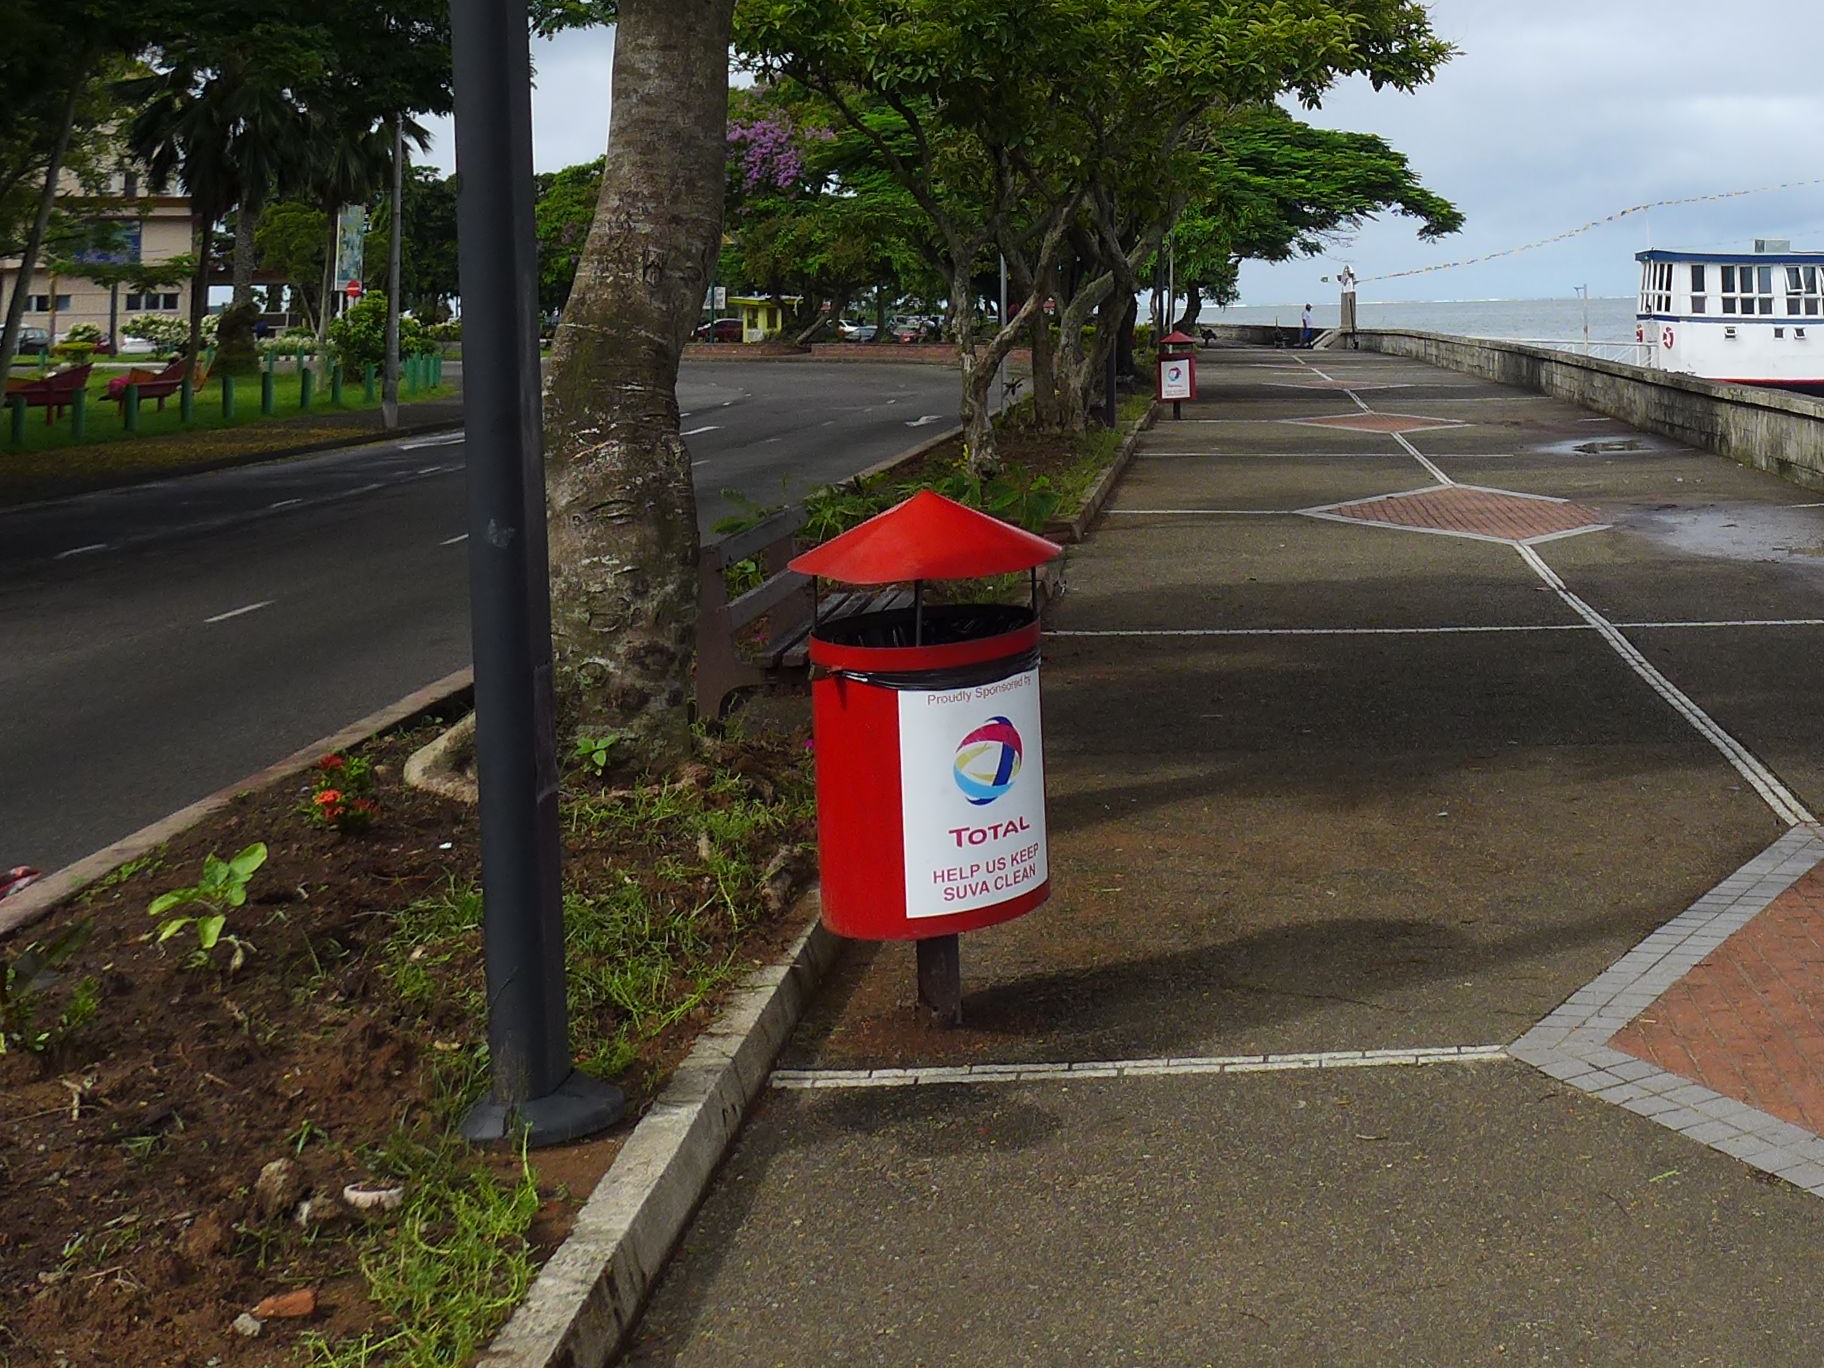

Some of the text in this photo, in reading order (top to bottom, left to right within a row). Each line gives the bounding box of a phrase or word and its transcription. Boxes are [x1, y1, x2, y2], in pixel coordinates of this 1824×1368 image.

[927, 674, 1032, 706] Proudly Sponsored by
[948, 816, 1030, 848] TOTAL
[933, 842, 1039, 884] HELP US KEEP
[943, 862, 1036, 902] SUVA CLEAN
